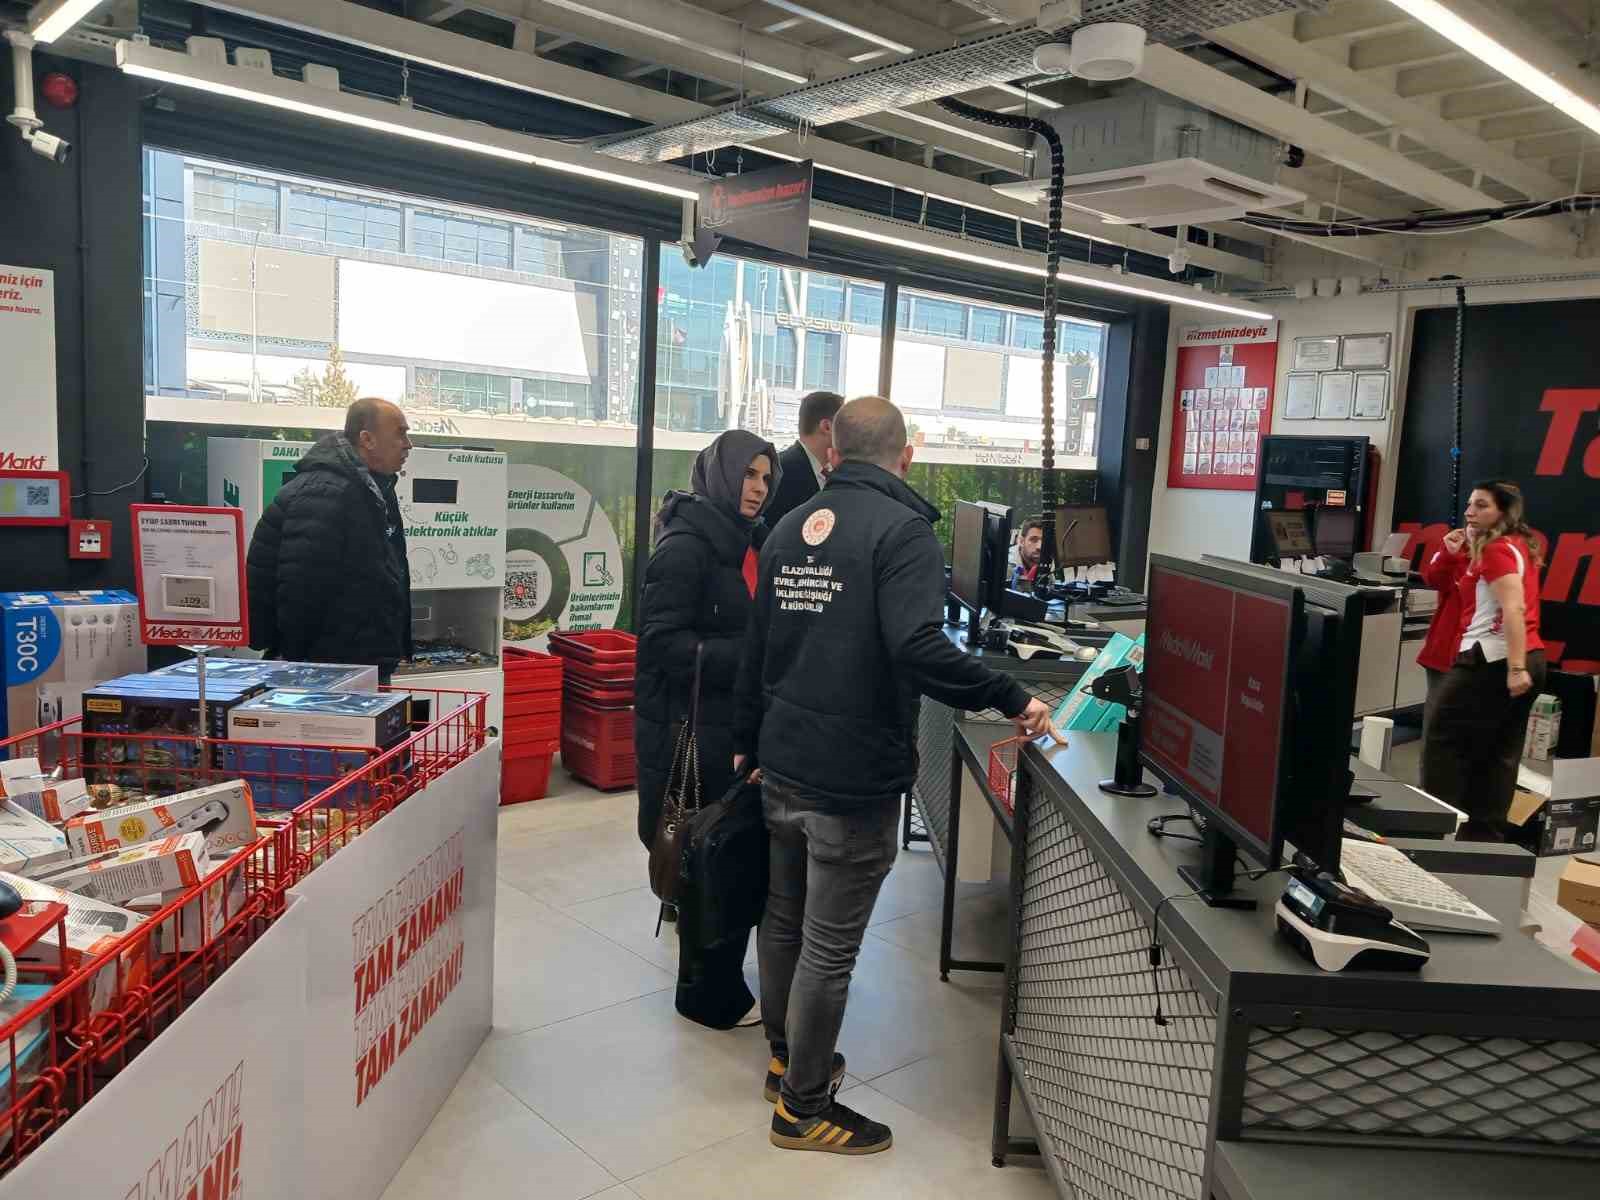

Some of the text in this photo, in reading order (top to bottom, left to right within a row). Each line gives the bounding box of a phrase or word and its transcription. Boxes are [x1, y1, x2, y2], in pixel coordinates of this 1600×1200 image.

[20, 274, 43, 288] için
[272, 447, 300, 457] DAHA
[474, 454, 504, 465] kutusu
[507, 490, 533, 501] Enerji
[434, 511, 469, 524] Küçük
[401, 525, 498, 537] elektronik atıklar
[831, 581, 844, 591] VE
[145, 625, 242, 640] Media Markt
[354, 865, 465, 1017] TAM ZAMANI!
[355, 941, 465, 1108] TAM ZAMANI!
